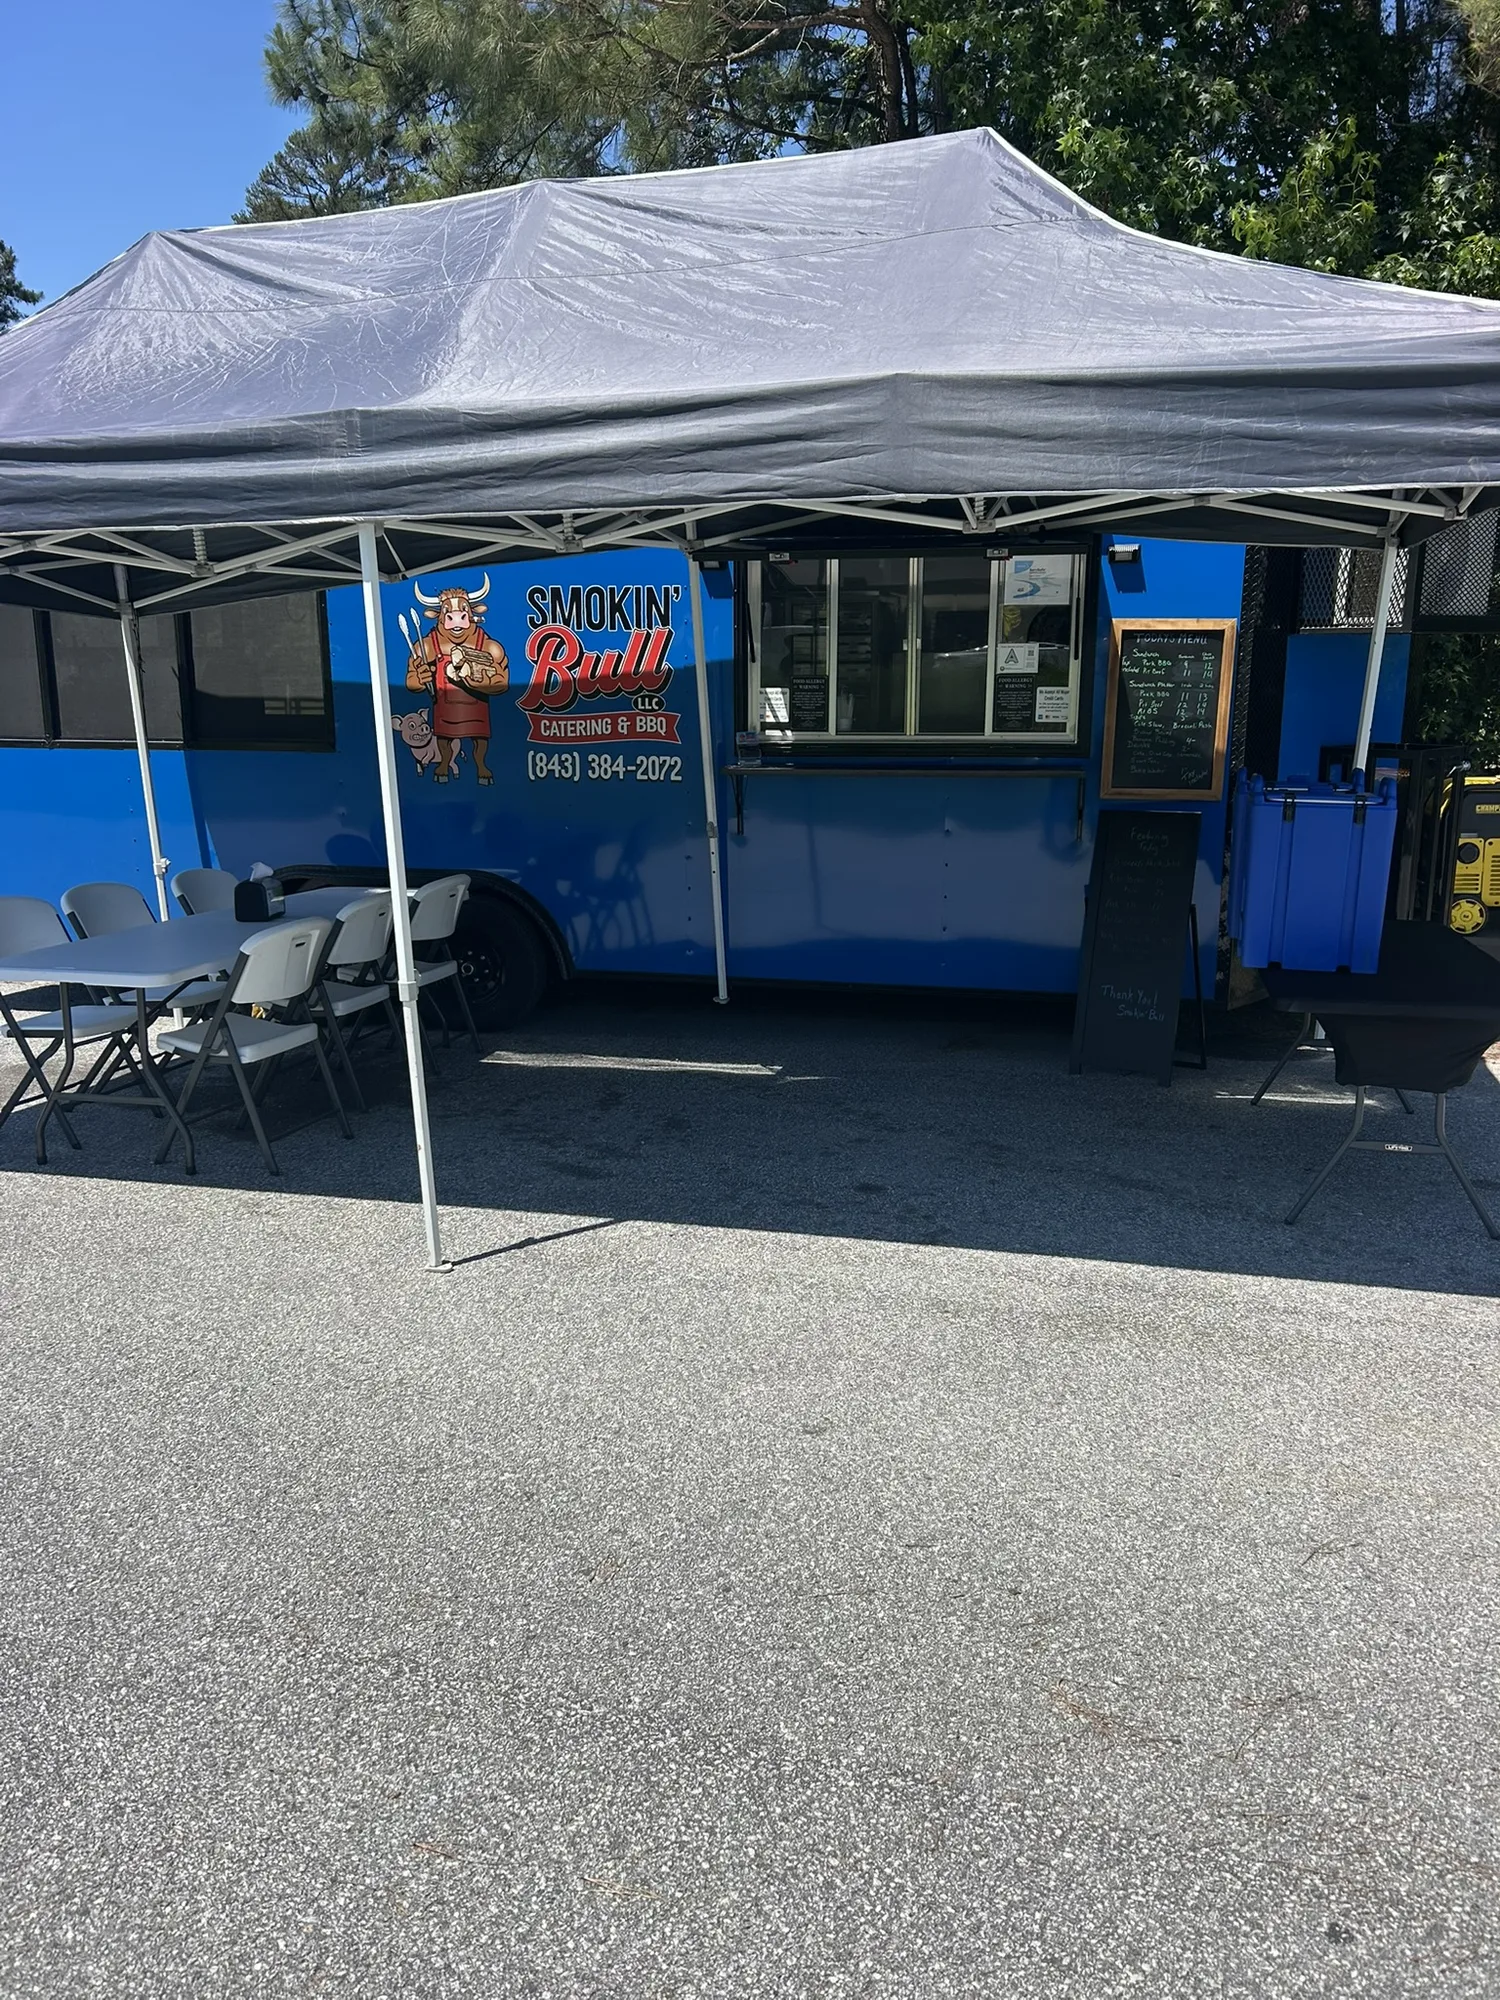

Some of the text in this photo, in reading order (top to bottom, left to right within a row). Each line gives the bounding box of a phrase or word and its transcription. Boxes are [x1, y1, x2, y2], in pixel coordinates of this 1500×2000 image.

[527, 585, 681, 632] SMOKIN'
[1177, 633, 1208, 645] MENU
[516, 624, 676, 713] Bull
[1183, 669, 1191, 677] 11
[1204, 662, 1213, 670] 12
[637, 697, 659, 710] LLC
[1181, 692, 1190, 701] 11
[1198, 692, 1208, 702] 13
[540, 716, 668, 737] CATERING & BBQ
[527, 751, 682, 781] (843) 384-2072
[1101, 984, 1134, 1003] Thank
